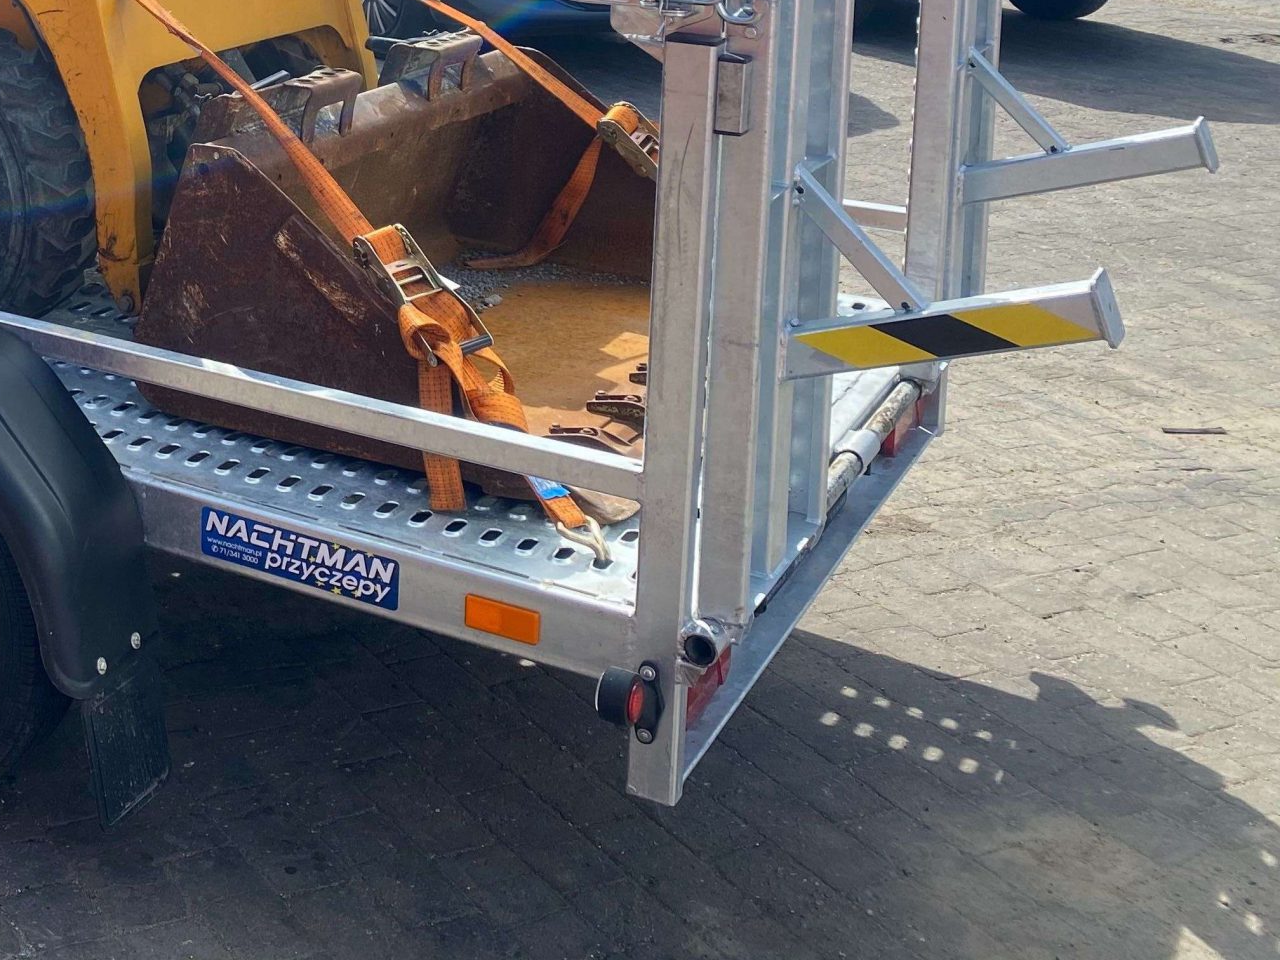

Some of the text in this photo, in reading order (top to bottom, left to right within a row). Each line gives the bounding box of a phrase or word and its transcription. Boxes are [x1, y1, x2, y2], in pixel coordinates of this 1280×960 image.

[205, 511, 395, 584] NACHTMAN
[207, 536, 262, 557] www.nachtman.pl
[219, 548, 259, 565] 71/341 3000
[265, 551, 391, 603] przyczepy
